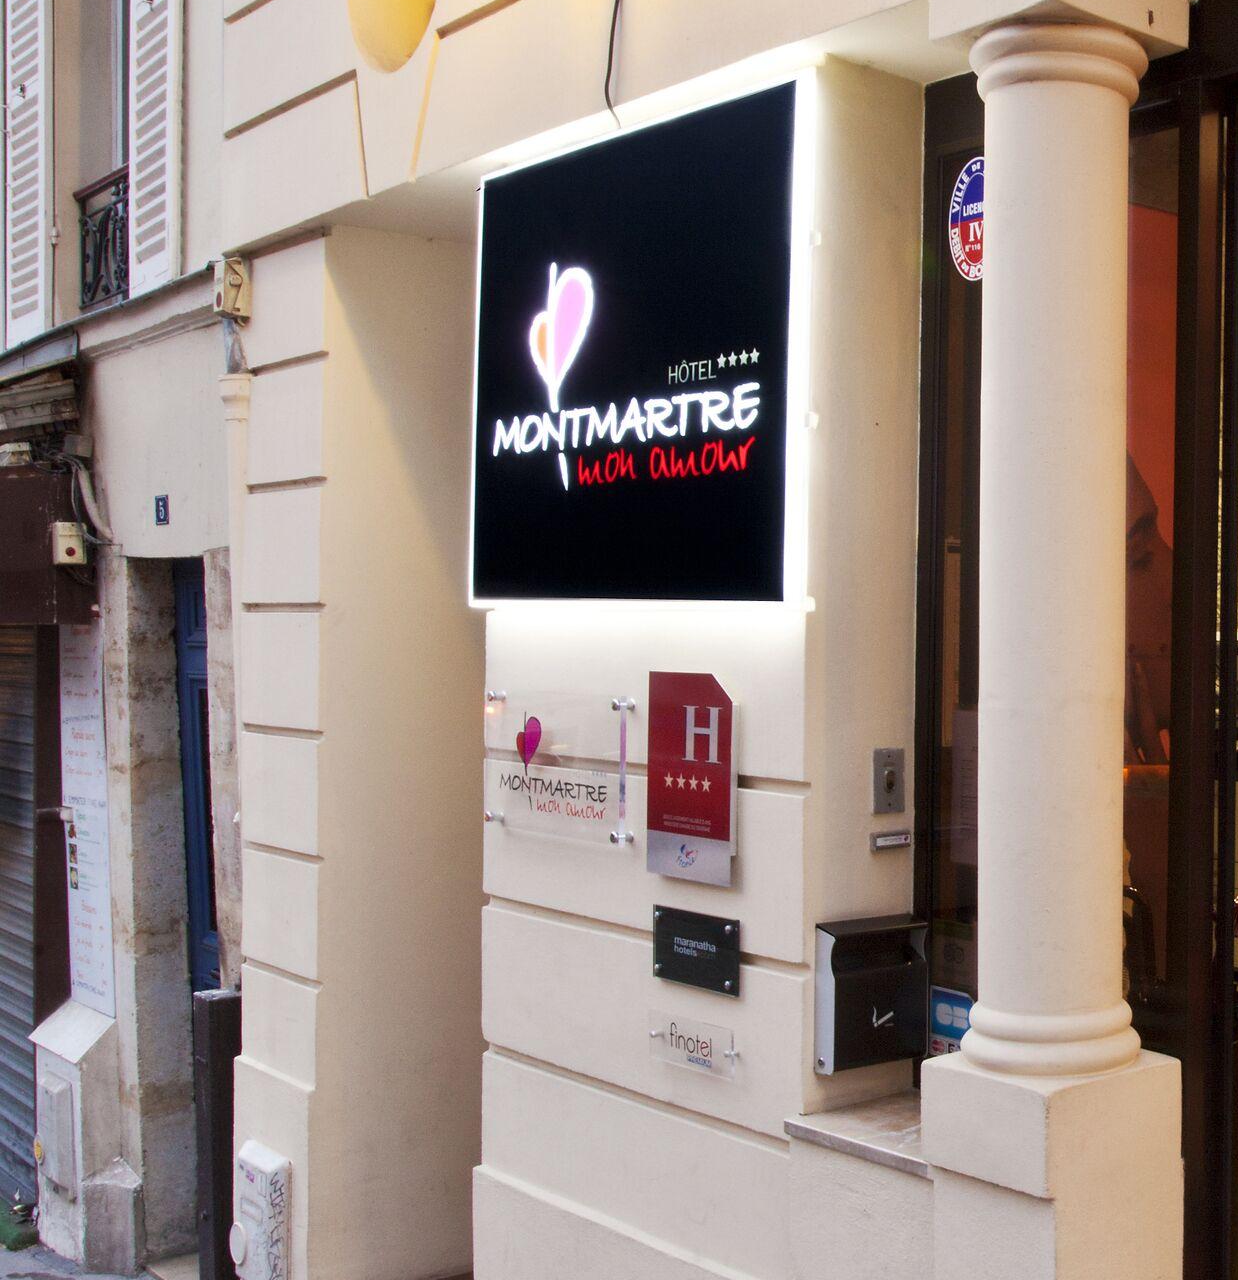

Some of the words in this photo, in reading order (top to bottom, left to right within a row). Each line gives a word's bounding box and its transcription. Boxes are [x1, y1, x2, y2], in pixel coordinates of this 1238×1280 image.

[952, 173, 970, 213] VILLE
[971, 161, 981, 173] DE
[950, 227, 965, 264] DEBIT
[668, 358, 717, 385] HÔTEL
[492, 382, 761, 457] MONTMARTRE
[577, 448, 637, 487] mon
[649, 436, 757, 480] amour
[682, 705, 723, 764] H
[500, 773, 607, 803] MONTMARTRE
[536, 799, 560, 814] mon
[565, 801, 605, 820] amour
[674, 936, 716, 952] maranatha
[670, 1022, 712, 1058] finotel
